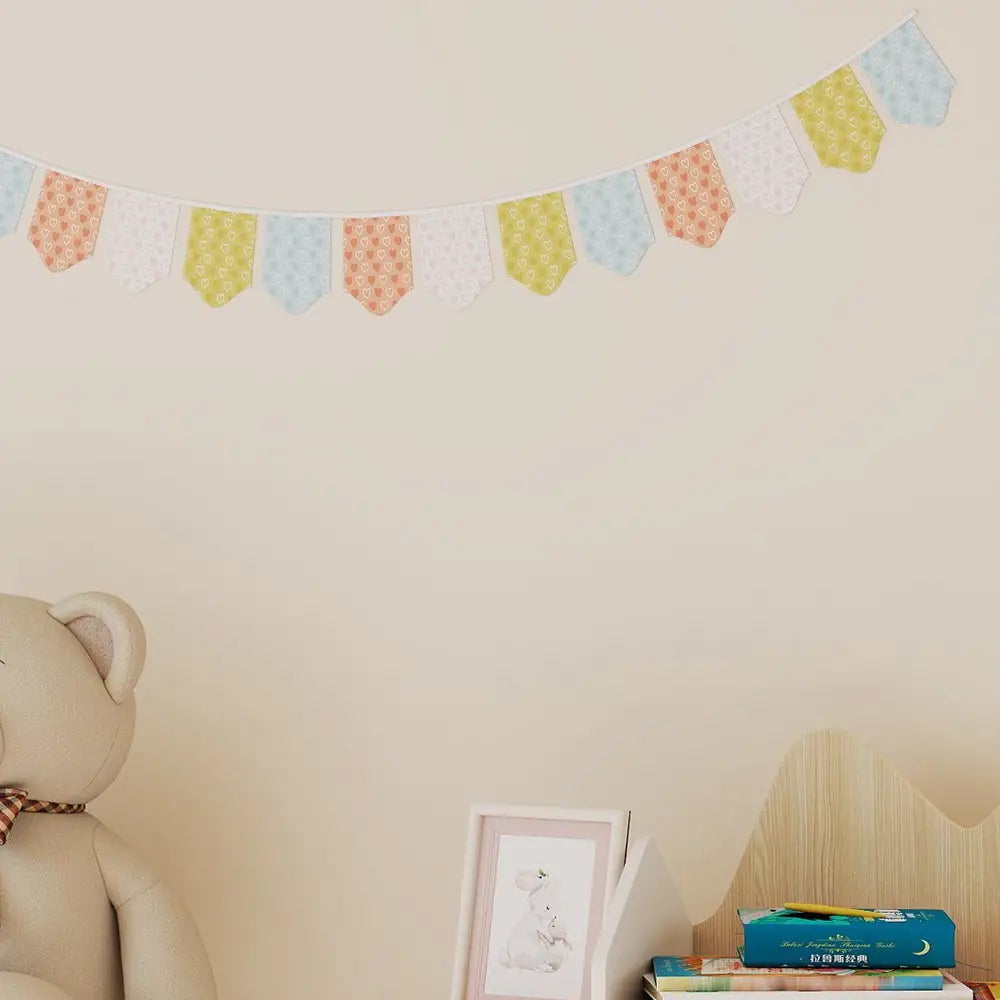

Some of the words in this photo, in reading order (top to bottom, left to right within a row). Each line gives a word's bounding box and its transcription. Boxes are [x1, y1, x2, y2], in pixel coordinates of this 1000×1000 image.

[809, 953, 868, 964] 拉鲁斯经典
